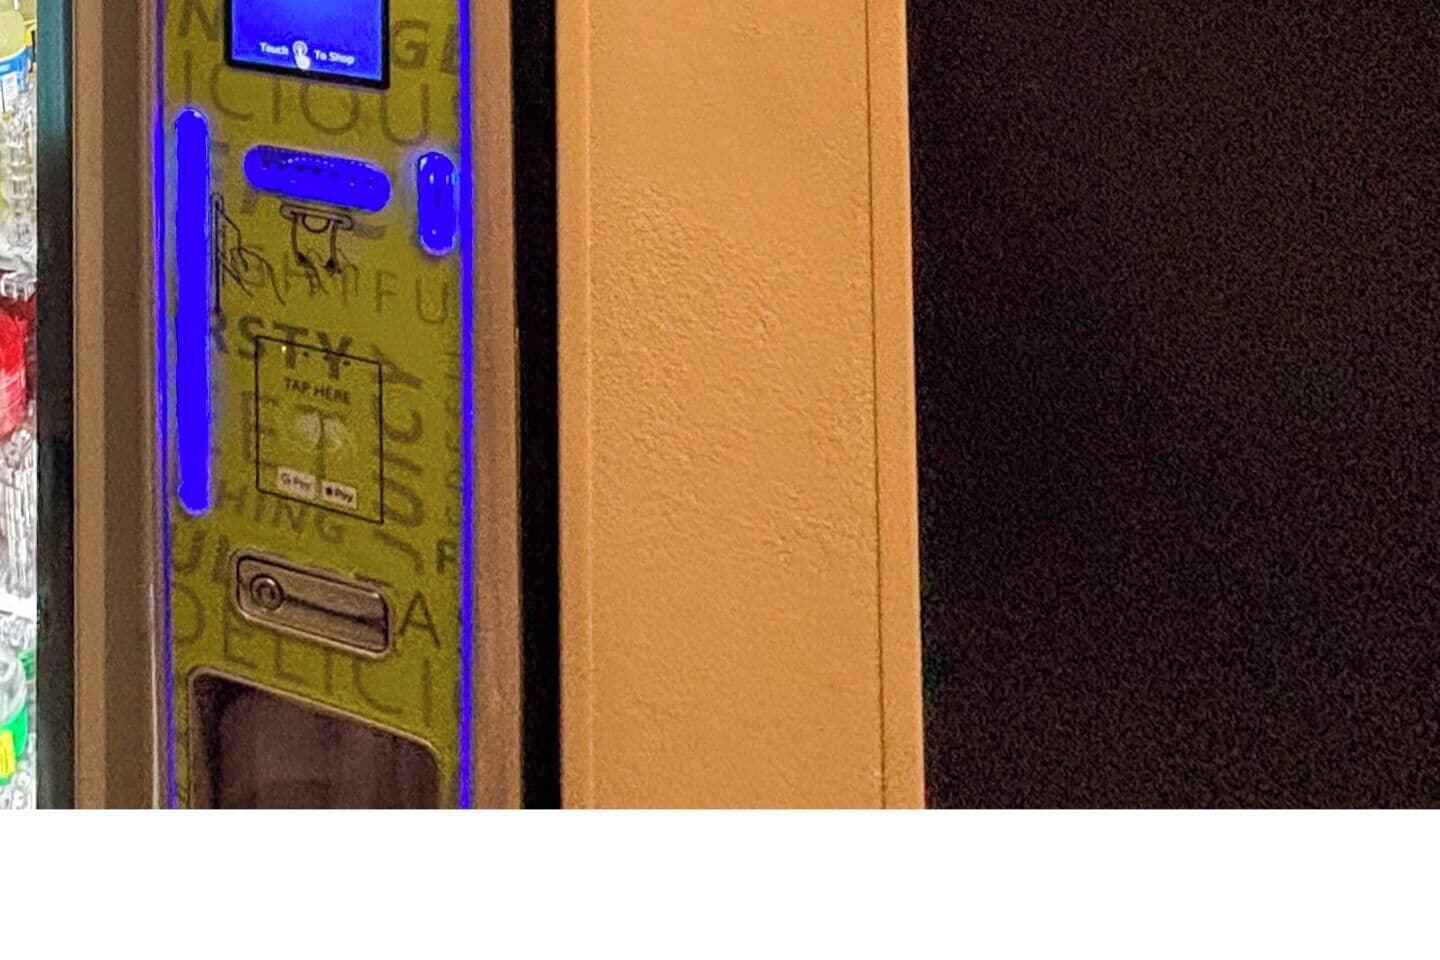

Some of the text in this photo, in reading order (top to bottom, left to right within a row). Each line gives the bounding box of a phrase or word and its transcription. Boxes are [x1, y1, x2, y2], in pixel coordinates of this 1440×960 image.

[259, 42, 355, 66] Touch To Shop
[284, 377, 352, 406] TAP HERE
